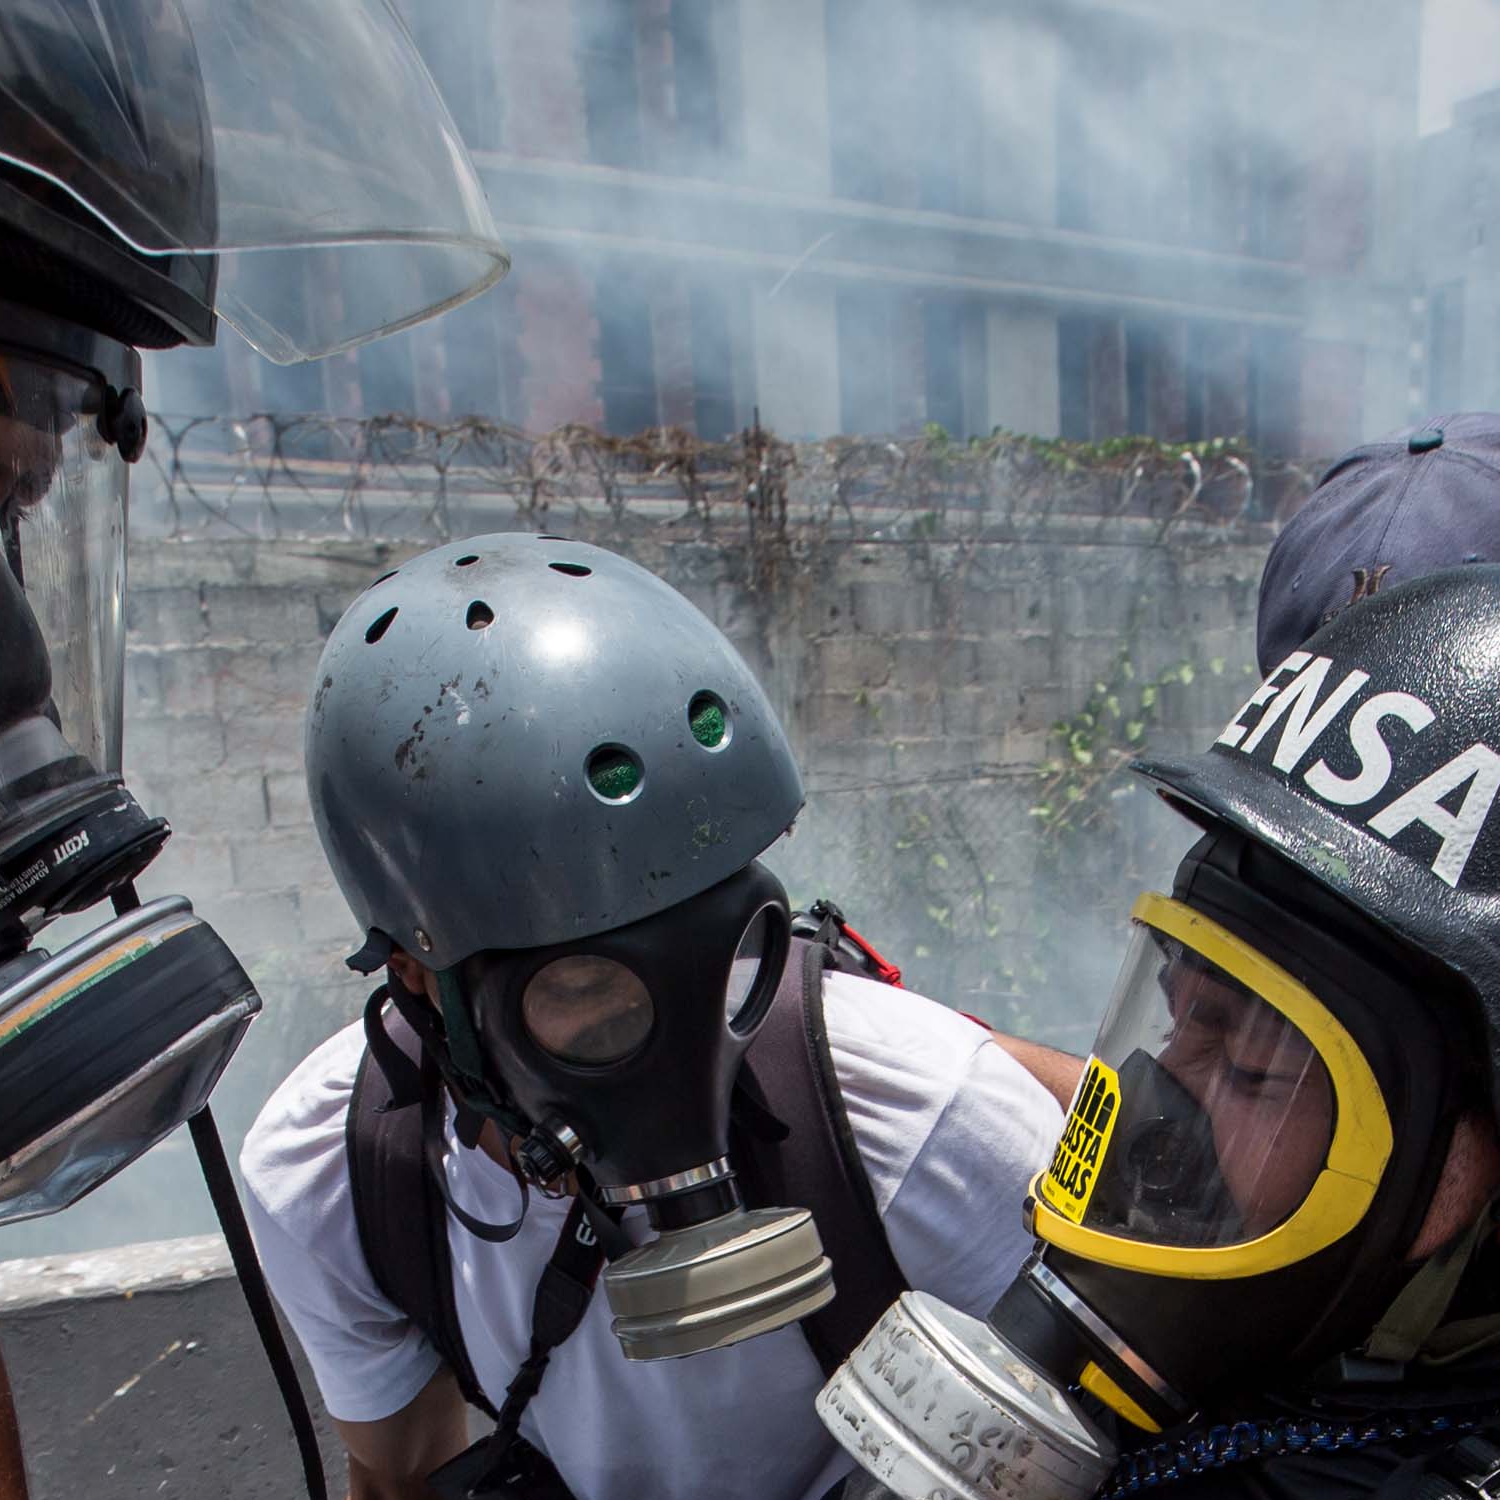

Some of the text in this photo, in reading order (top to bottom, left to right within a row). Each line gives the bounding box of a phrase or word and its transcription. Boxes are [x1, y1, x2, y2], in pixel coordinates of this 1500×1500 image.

[53, 830, 90, 865] SCOTT
[14, 866, 50, 895] ADAPTER
[1061, 1113, 1102, 1169] BASTA
[1049, 1142, 1093, 1201] BALAS
